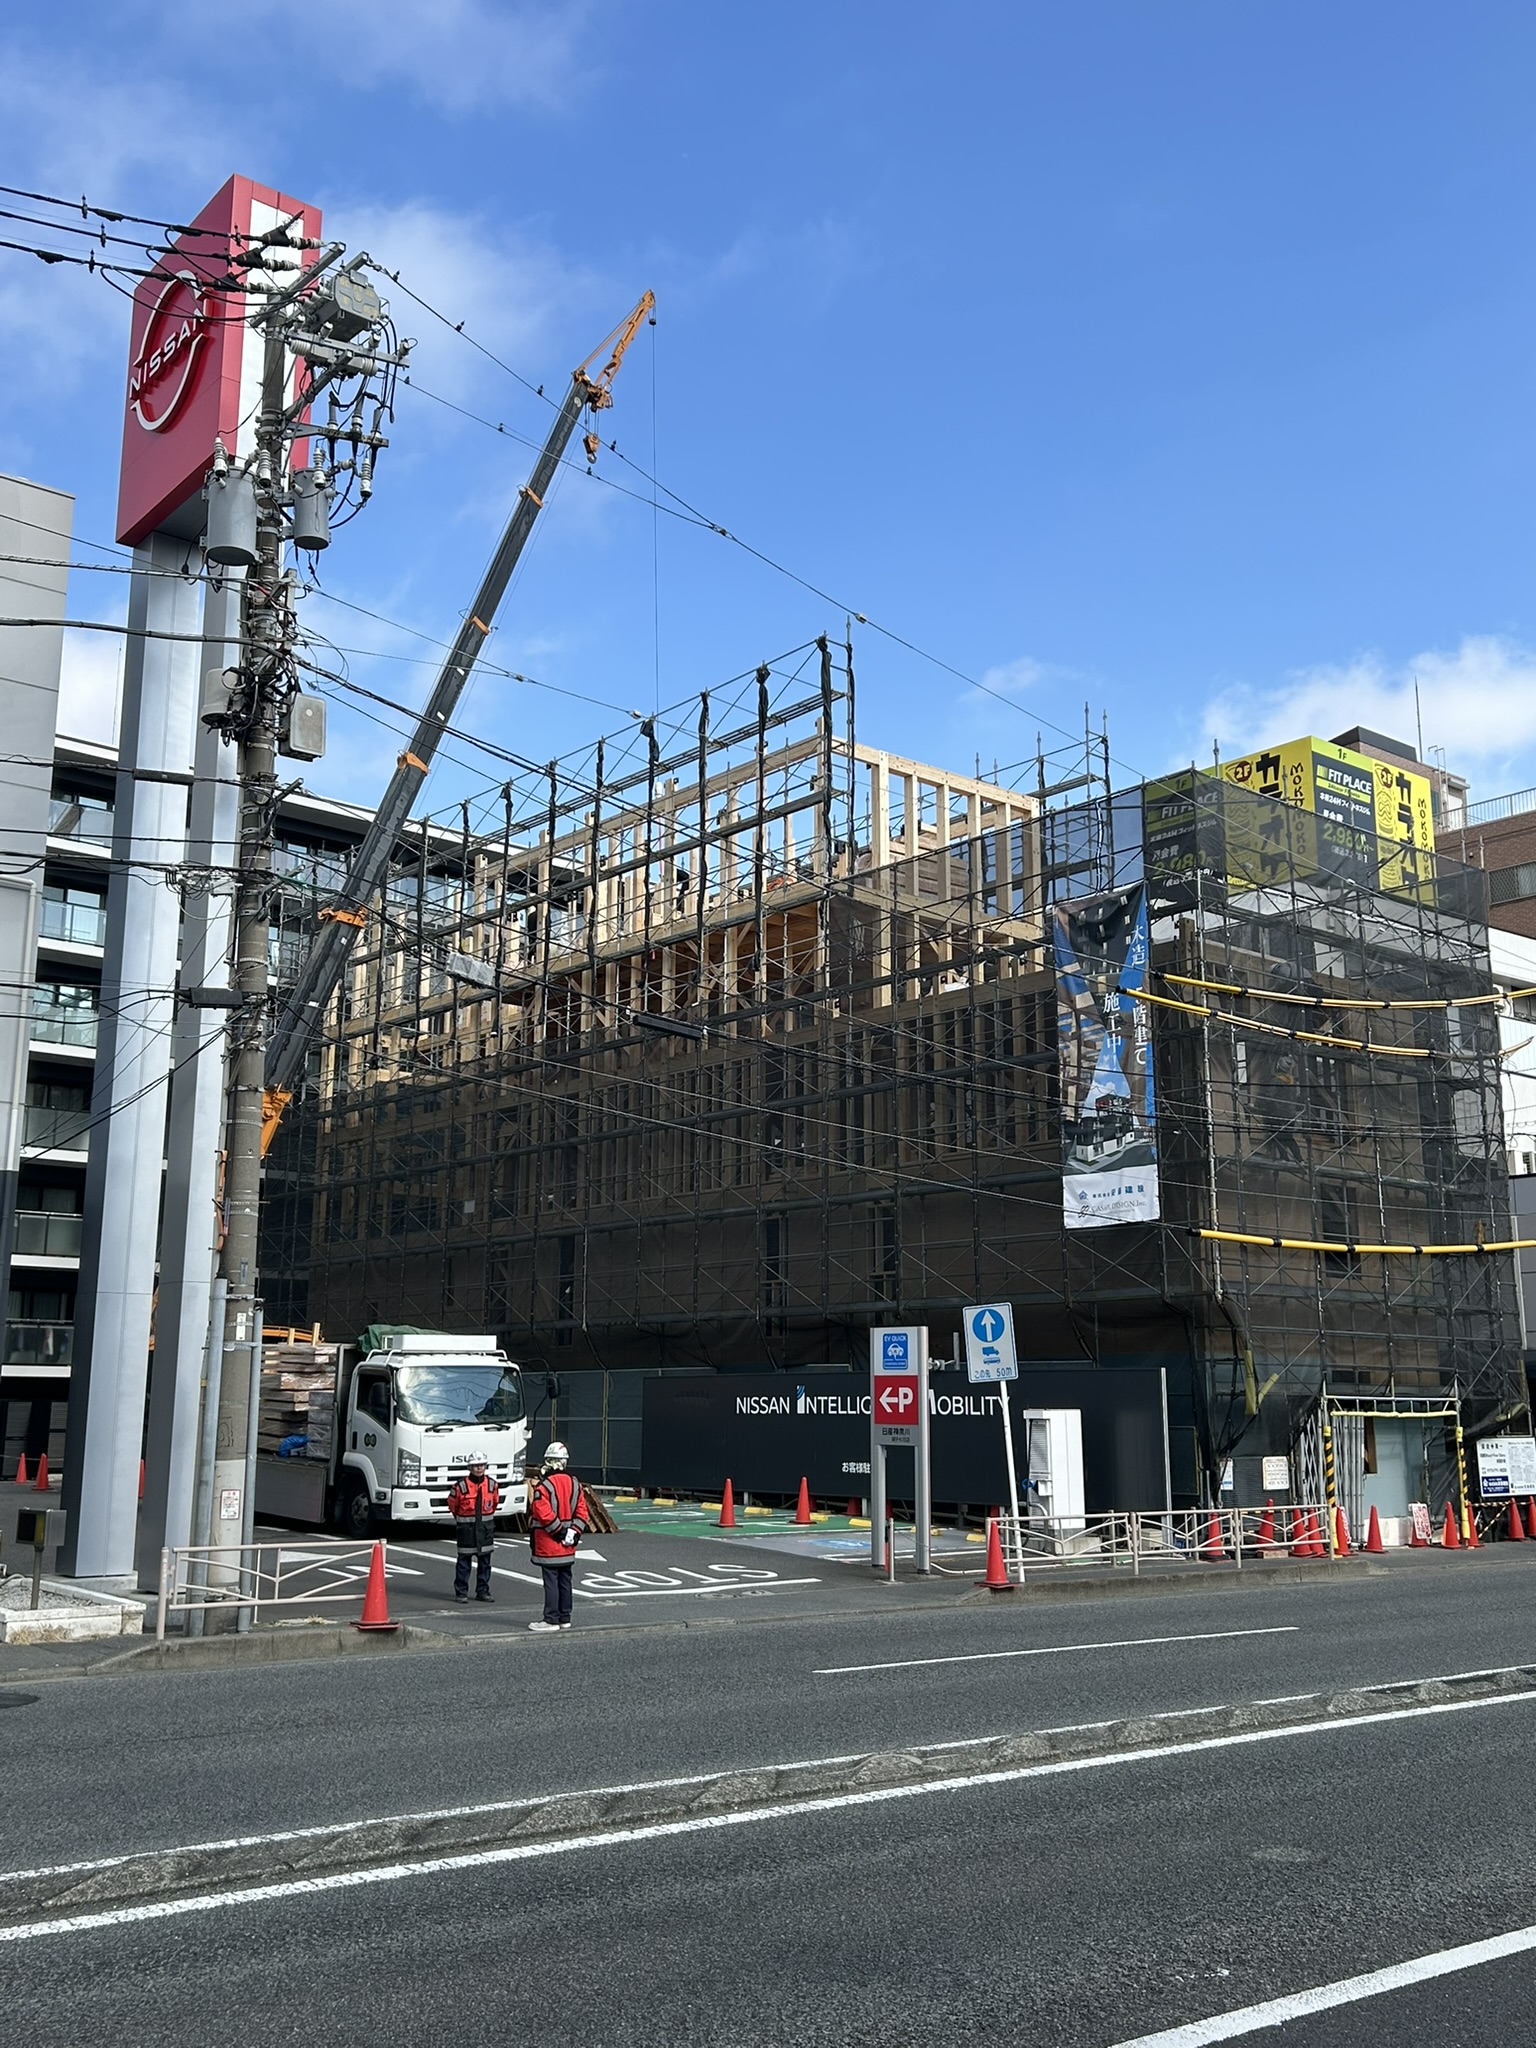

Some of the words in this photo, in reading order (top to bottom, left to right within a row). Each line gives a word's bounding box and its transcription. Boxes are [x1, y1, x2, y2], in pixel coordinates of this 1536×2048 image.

[129, 298, 207, 399] NISSAN
[1337, 748, 1348, 761] 1F
[1235, 764, 1252, 779] 2F
[1328, 768, 1342, 785] FIT
[1343, 774, 1372, 794] PLACE
[1380, 769, 1393, 786] 2F
[1130, 924, 1145, 967] 木造
[996, 1366, 1012, 1378] 50m
[736, 1396, 790, 1415] NISSAN
[796, 1385, 872, 1415] INTELLIG
[898, 1387, 913, 1413] P
[841, 1462, 871, 1474] お客様駐
[580, 1563, 779, 1590] STOP
